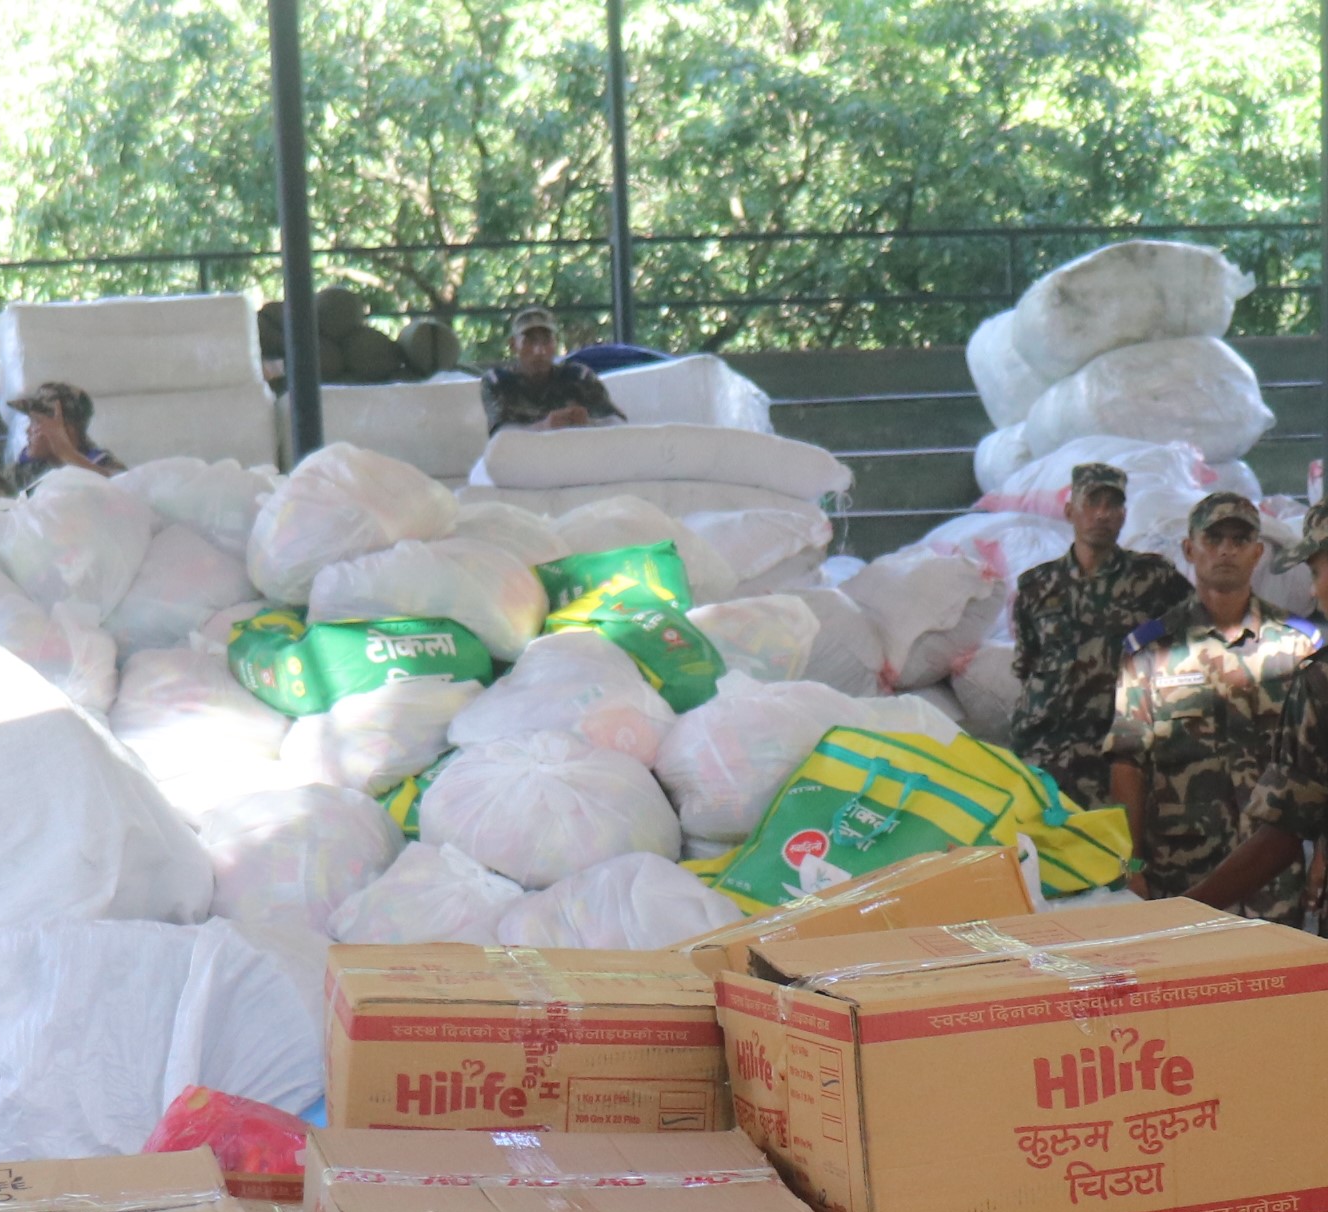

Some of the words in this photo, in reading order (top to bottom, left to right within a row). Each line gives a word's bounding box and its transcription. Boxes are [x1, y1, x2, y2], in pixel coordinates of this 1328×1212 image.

[393, 1023, 439, 1037] स्वस्थ
[442, 1024, 492, 1038] दिनको
[396, 1059, 528, 1118] Hilife
[1034, 1027, 1195, 1110] Hilife
[1014, 1121, 1112, 1169] कुरुम
[1124, 1099, 1220, 1153] कुरुम
[1064, 1162, 1164, 1204] चिउरा
